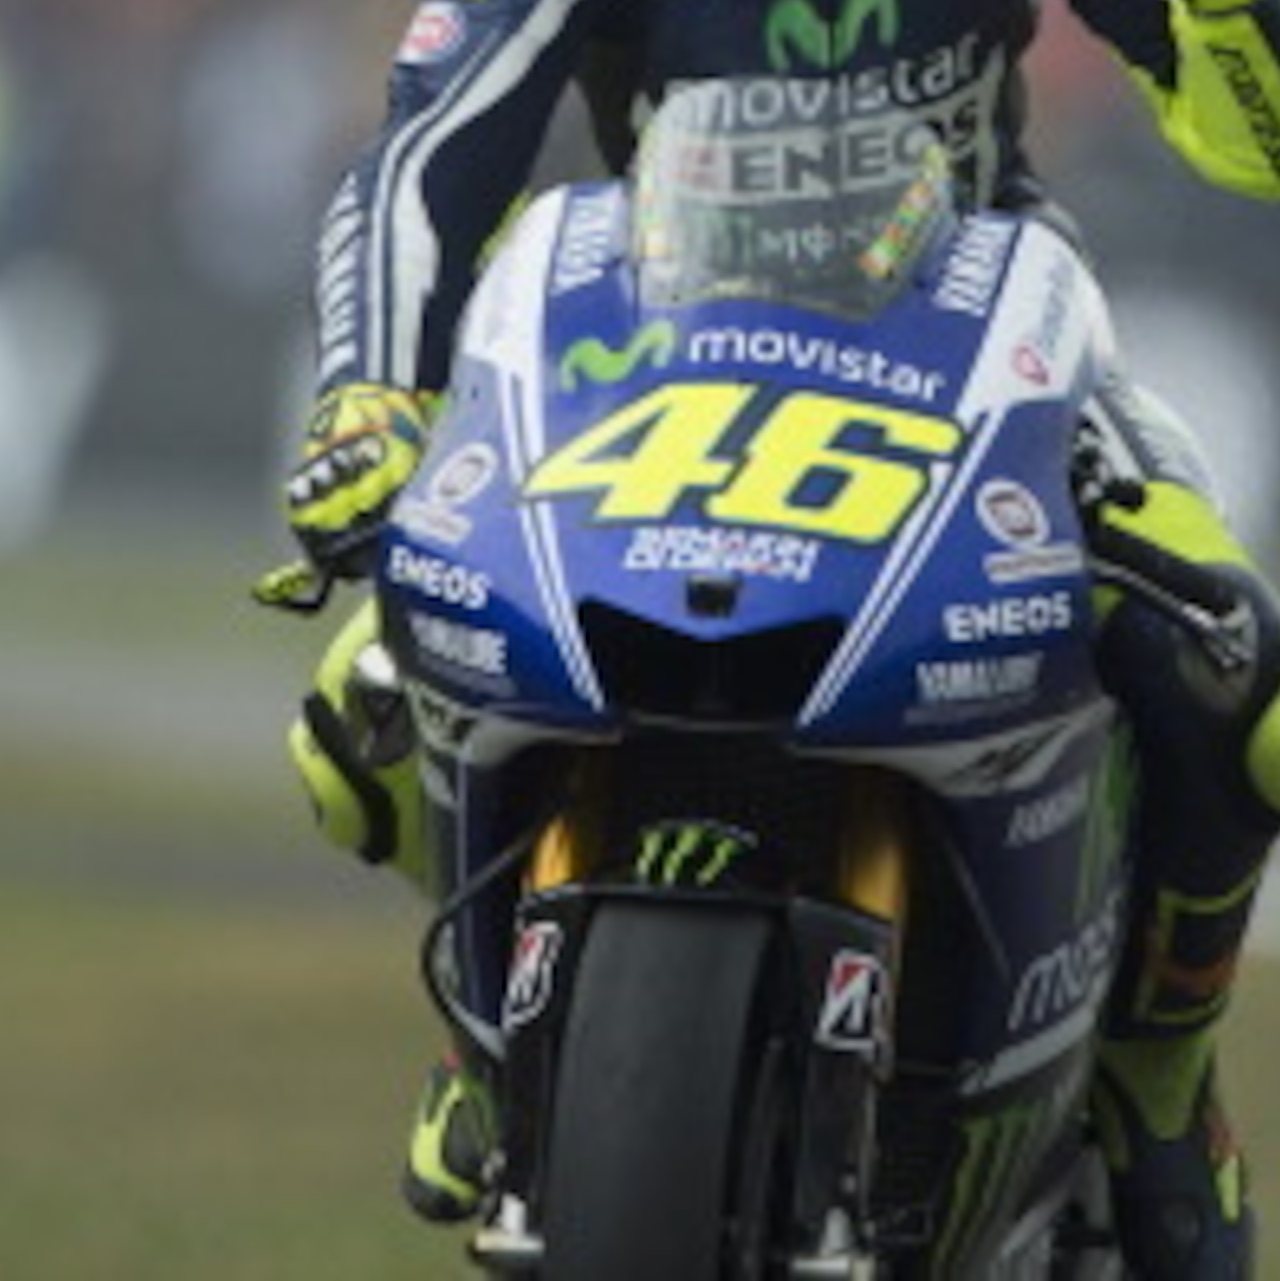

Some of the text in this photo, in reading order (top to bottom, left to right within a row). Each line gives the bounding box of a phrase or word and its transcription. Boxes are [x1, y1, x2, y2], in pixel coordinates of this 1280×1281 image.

[688, 326, 948, 401] movistar
[520, 379, 966, 545] 46
[389, 544, 490, 610] ENEOS
[943, 590, 1073, 643] ENEOS
